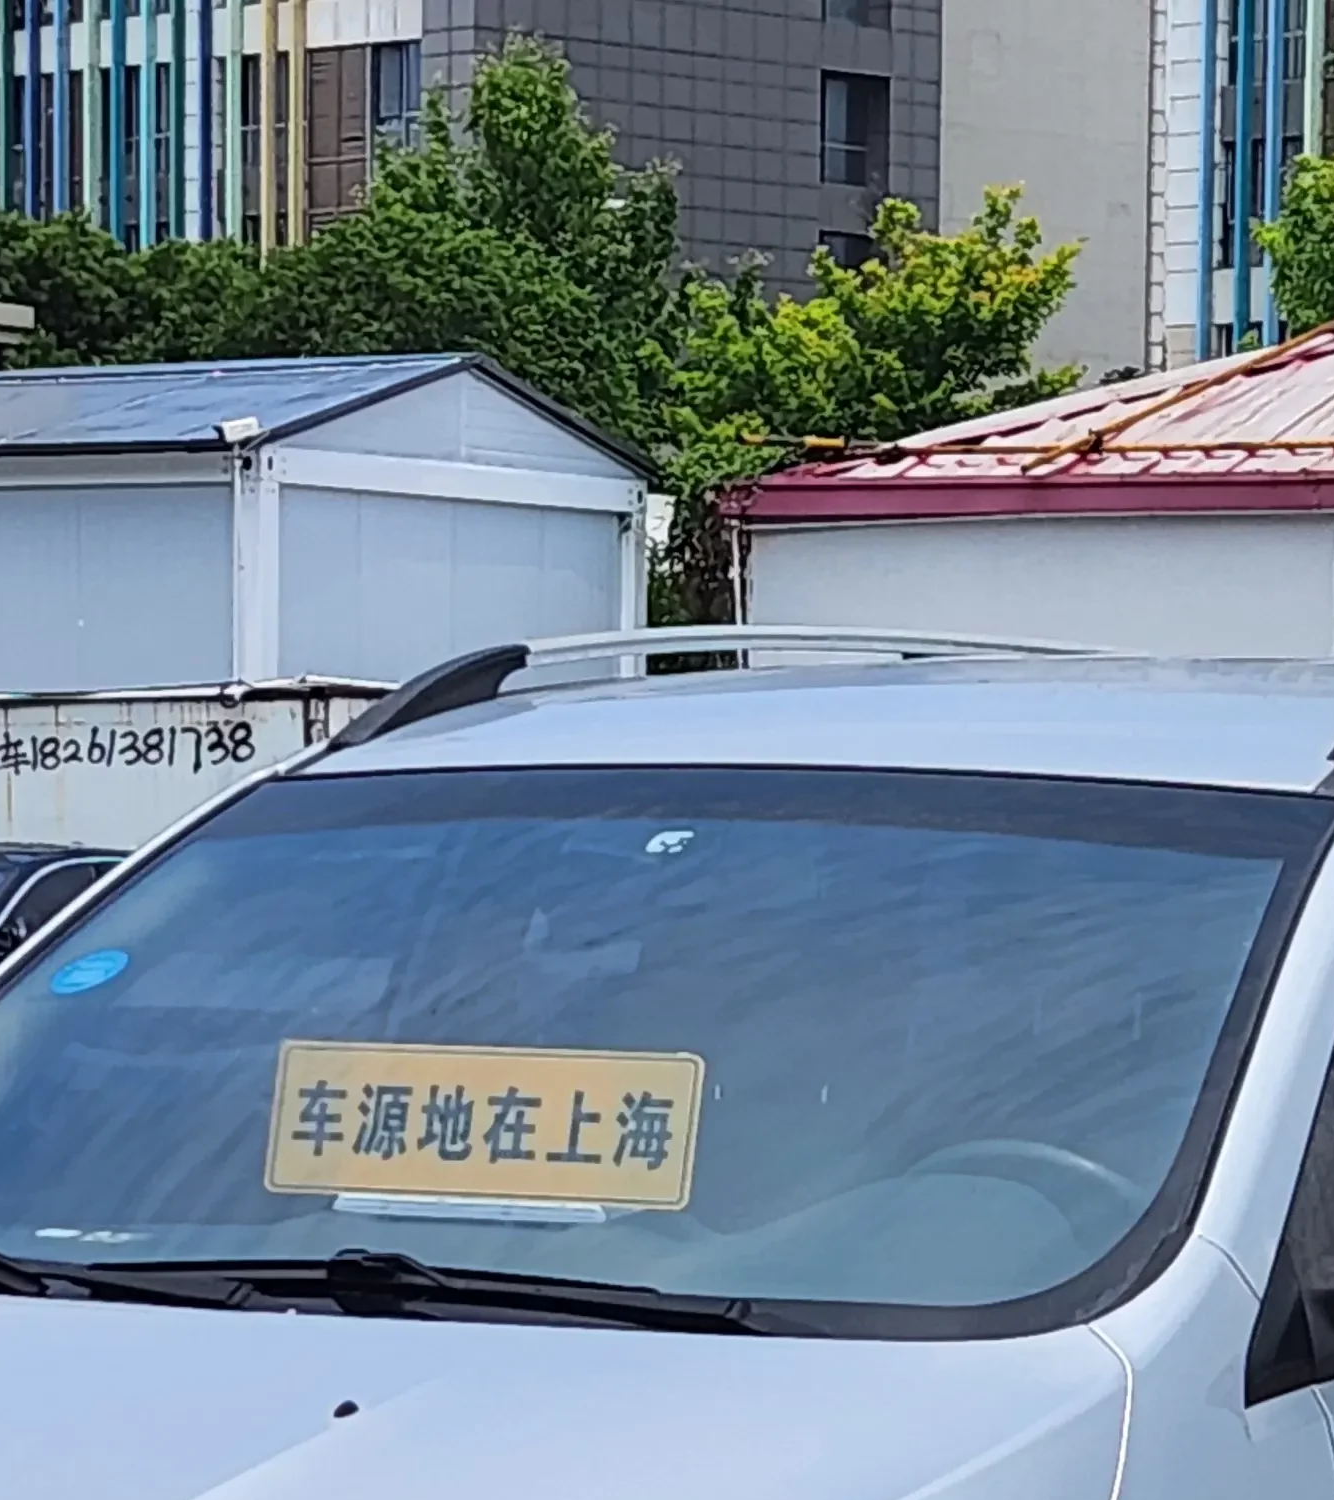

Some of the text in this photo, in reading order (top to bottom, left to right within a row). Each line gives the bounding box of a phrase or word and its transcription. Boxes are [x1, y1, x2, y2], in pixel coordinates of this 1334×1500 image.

[291, 1080, 674, 1171] 车源地在上海
